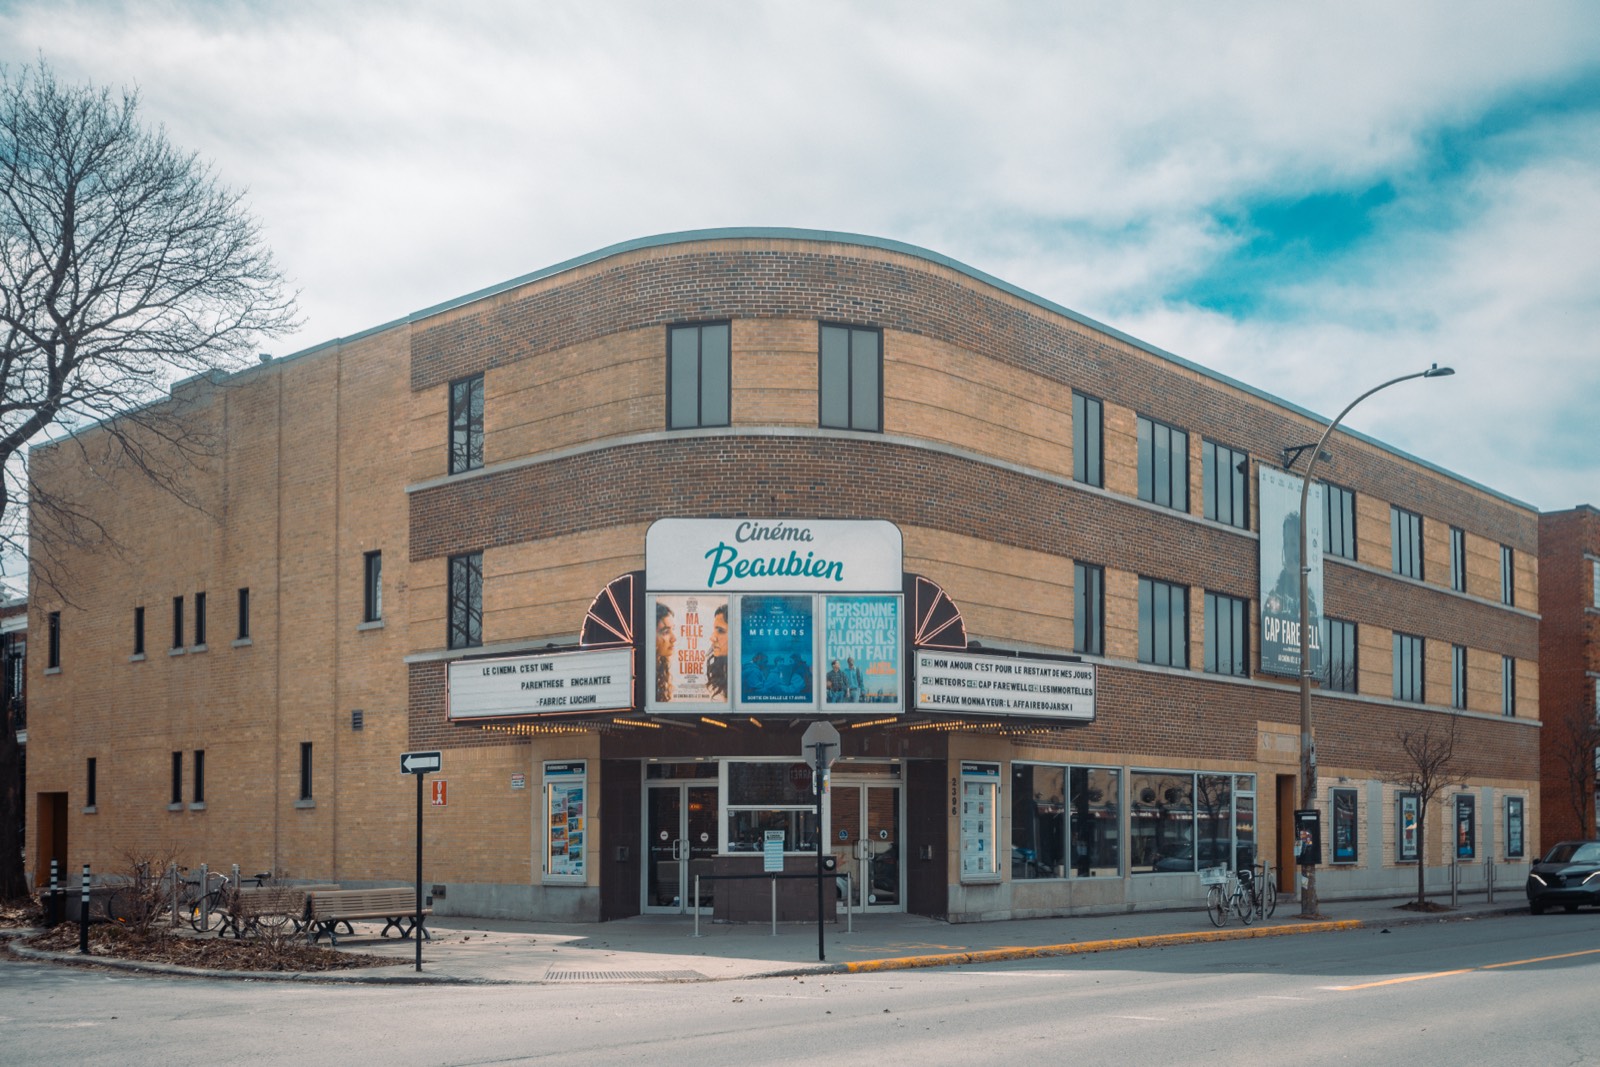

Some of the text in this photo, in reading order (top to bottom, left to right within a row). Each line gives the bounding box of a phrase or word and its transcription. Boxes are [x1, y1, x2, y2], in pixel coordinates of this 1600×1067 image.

[736, 522, 814, 544] Cinéma
[704, 541, 844, 588] Beaubien
[828, 602, 895, 616] PERSONNE
[686, 612, 699, 624] MA
[828, 617, 846, 630] N'Y
[681, 625, 704, 638] FILLE
[1264, 616, 1280, 642] CAP
[687, 638, 698, 650] TU
[828, 630, 895, 645] ALORS ILS
[678, 650, 706, 662] SERAS
[828, 646, 894, 660] L'ONT FAIT
[482, 663, 554, 676] LE CINEMA C'EST UNE
[680, 662, 704, 674] LIBRE
[934, 660, 948, 668] MON
[950, 661, 972, 671] AMOUR
[995, 665, 1012, 674] POUR
[1014, 666, 1022, 674] LE
[1024, 667, 1051, 677] RESTANT
[1052, 669, 1060, 678] DE
[1060, 670, 1072, 678] MES
[1073, 671, 1092, 680] JOURS
[521, 676, 611, 690] PARENTHESE ENCHANTEE
[934, 678, 966, 687] METEORS
[978, 680, 992, 689] CAP
[993, 681, 1028, 692] FAREWELL
[570, 694, 597, 705] LUCHINI
[933, 695, 941, 703] LE
[942, 696, 960, 705] FAUX
